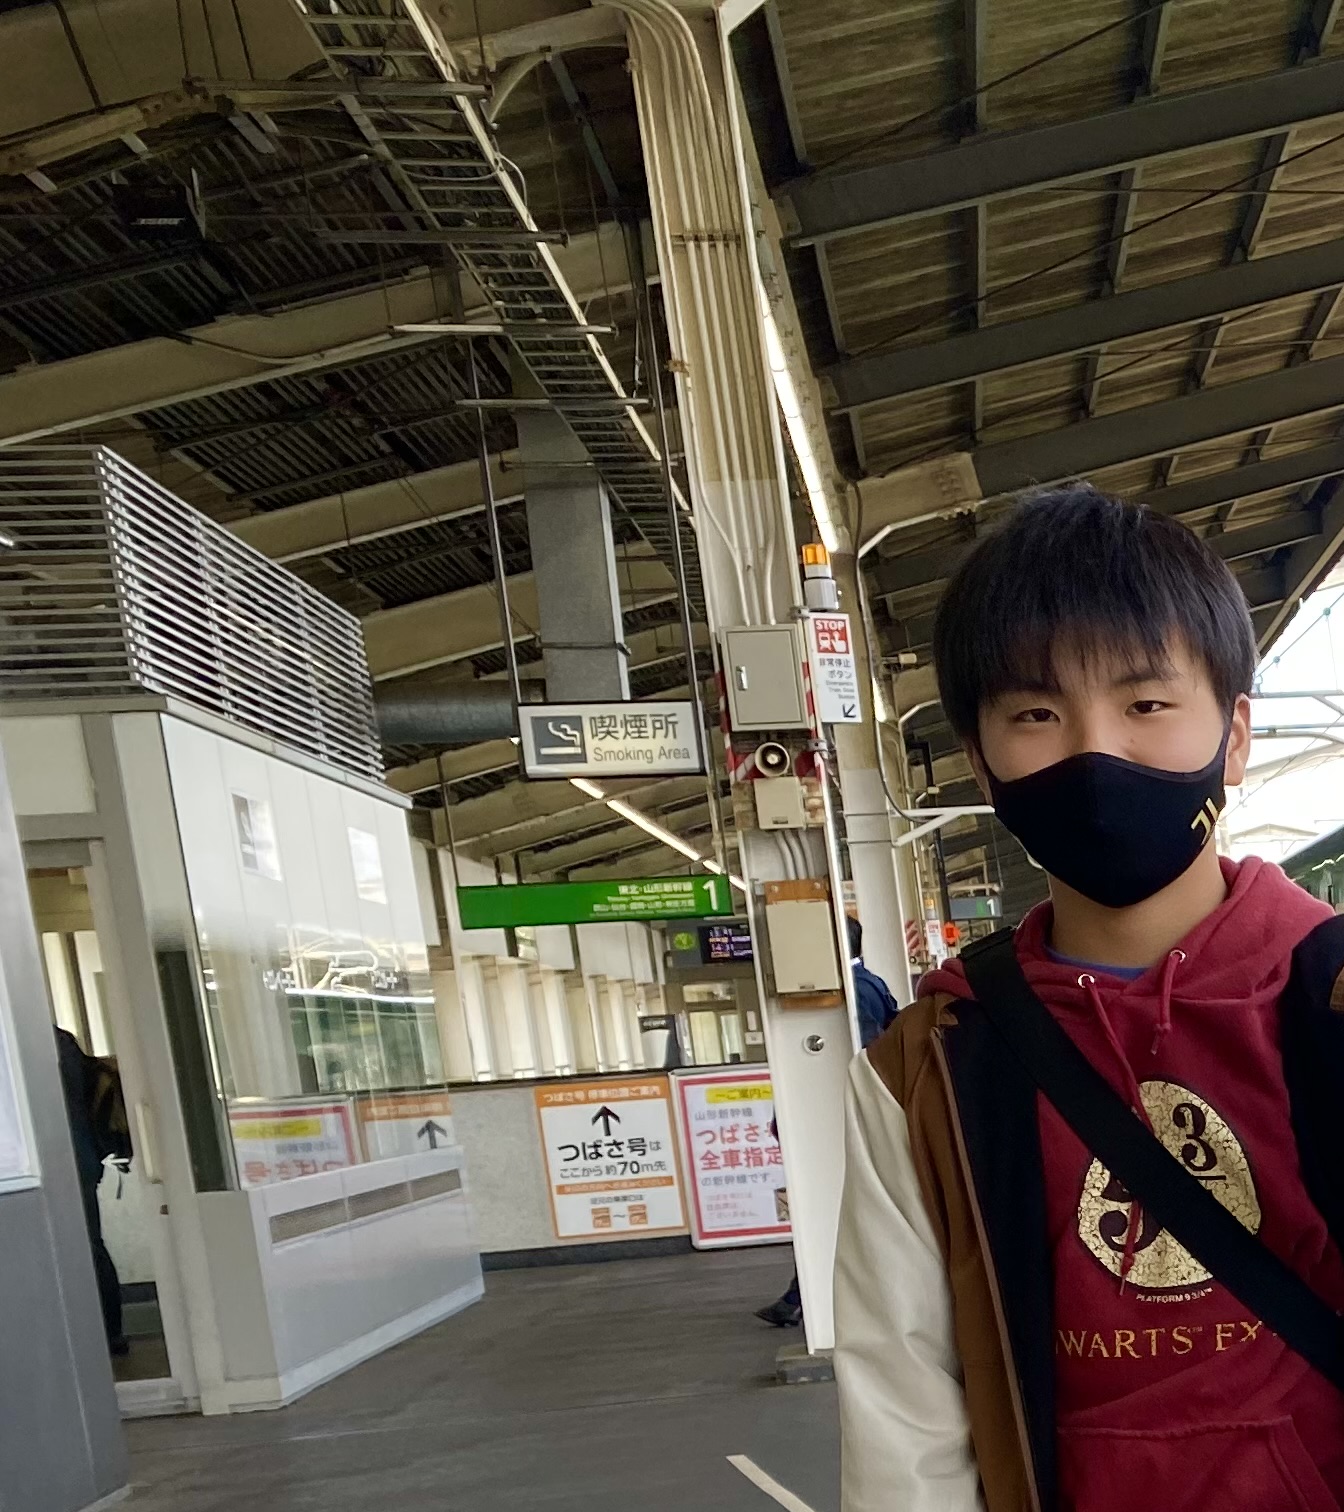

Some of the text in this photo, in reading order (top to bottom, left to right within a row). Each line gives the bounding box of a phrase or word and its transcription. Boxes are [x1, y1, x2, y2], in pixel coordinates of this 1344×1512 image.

[815, 620, 845, 630] STOP
[828, 669, 852, 679] ボタン
[589, 713, 678, 741] 喫煙所
[593, 745, 691, 763] Smoking Area
[702, 880, 718, 911] 1
[694, 1107, 753, 1121] 山形新幹線
[1173, 1102, 1218, 1171] 3
[1136, 1292, 1183, 1304] PLATFORM
[1184, 1292, 1191, 1301] 9
[1056, 1320, 1278, 1359] WARTS EX
